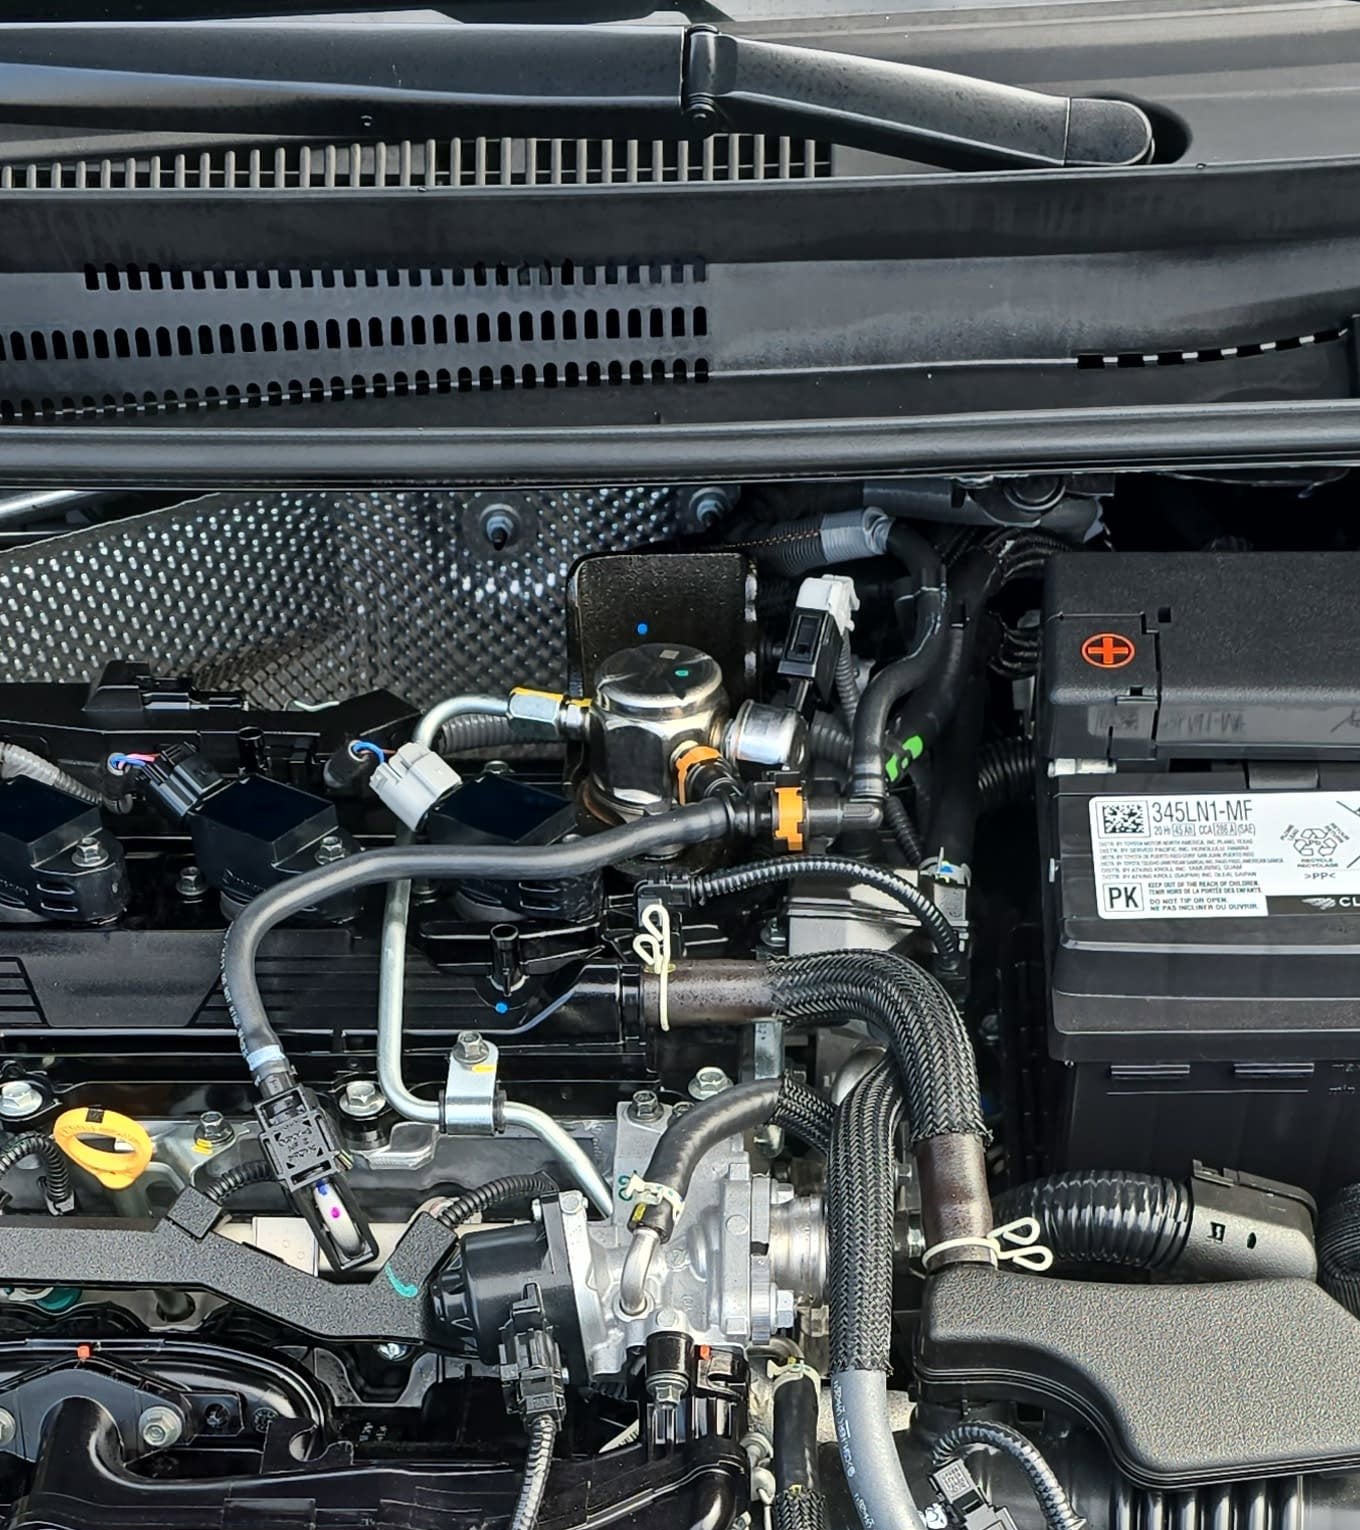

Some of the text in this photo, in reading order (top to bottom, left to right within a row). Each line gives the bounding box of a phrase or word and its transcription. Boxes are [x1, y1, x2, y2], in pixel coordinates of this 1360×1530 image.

[1151, 800, 1254, 823] 345LN1-MF
[1198, 823, 1213, 834] CCA
[1237, 823, 1256, 836] (SAE)
[1304, 872, 1336, 880] >PP<
[1108, 885, 1140, 909] PK
